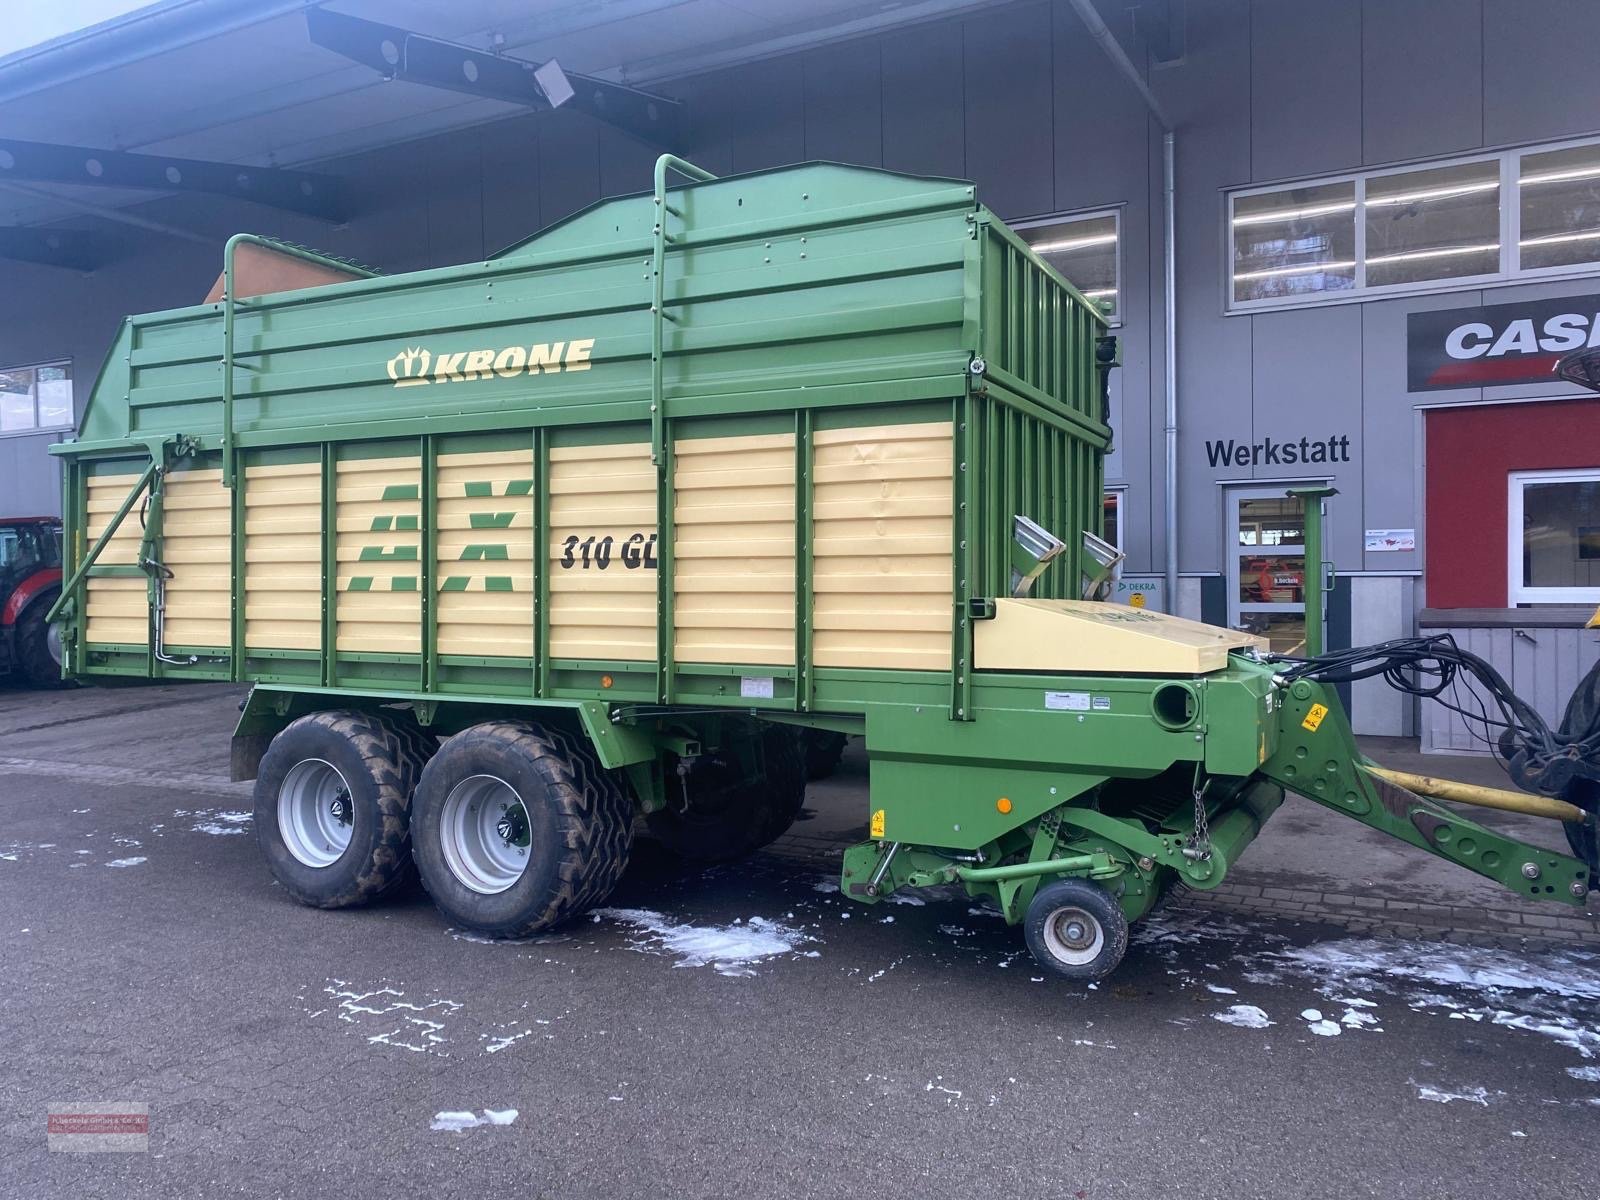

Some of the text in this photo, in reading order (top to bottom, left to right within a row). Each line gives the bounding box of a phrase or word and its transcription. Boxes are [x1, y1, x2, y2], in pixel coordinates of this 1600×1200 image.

[434, 338, 596, 385] KRONE
[1205, 434, 1350, 468] Werkstatt
[560, 535, 614, 570] 310
[1129, 582, 1157, 591] DEKRA
